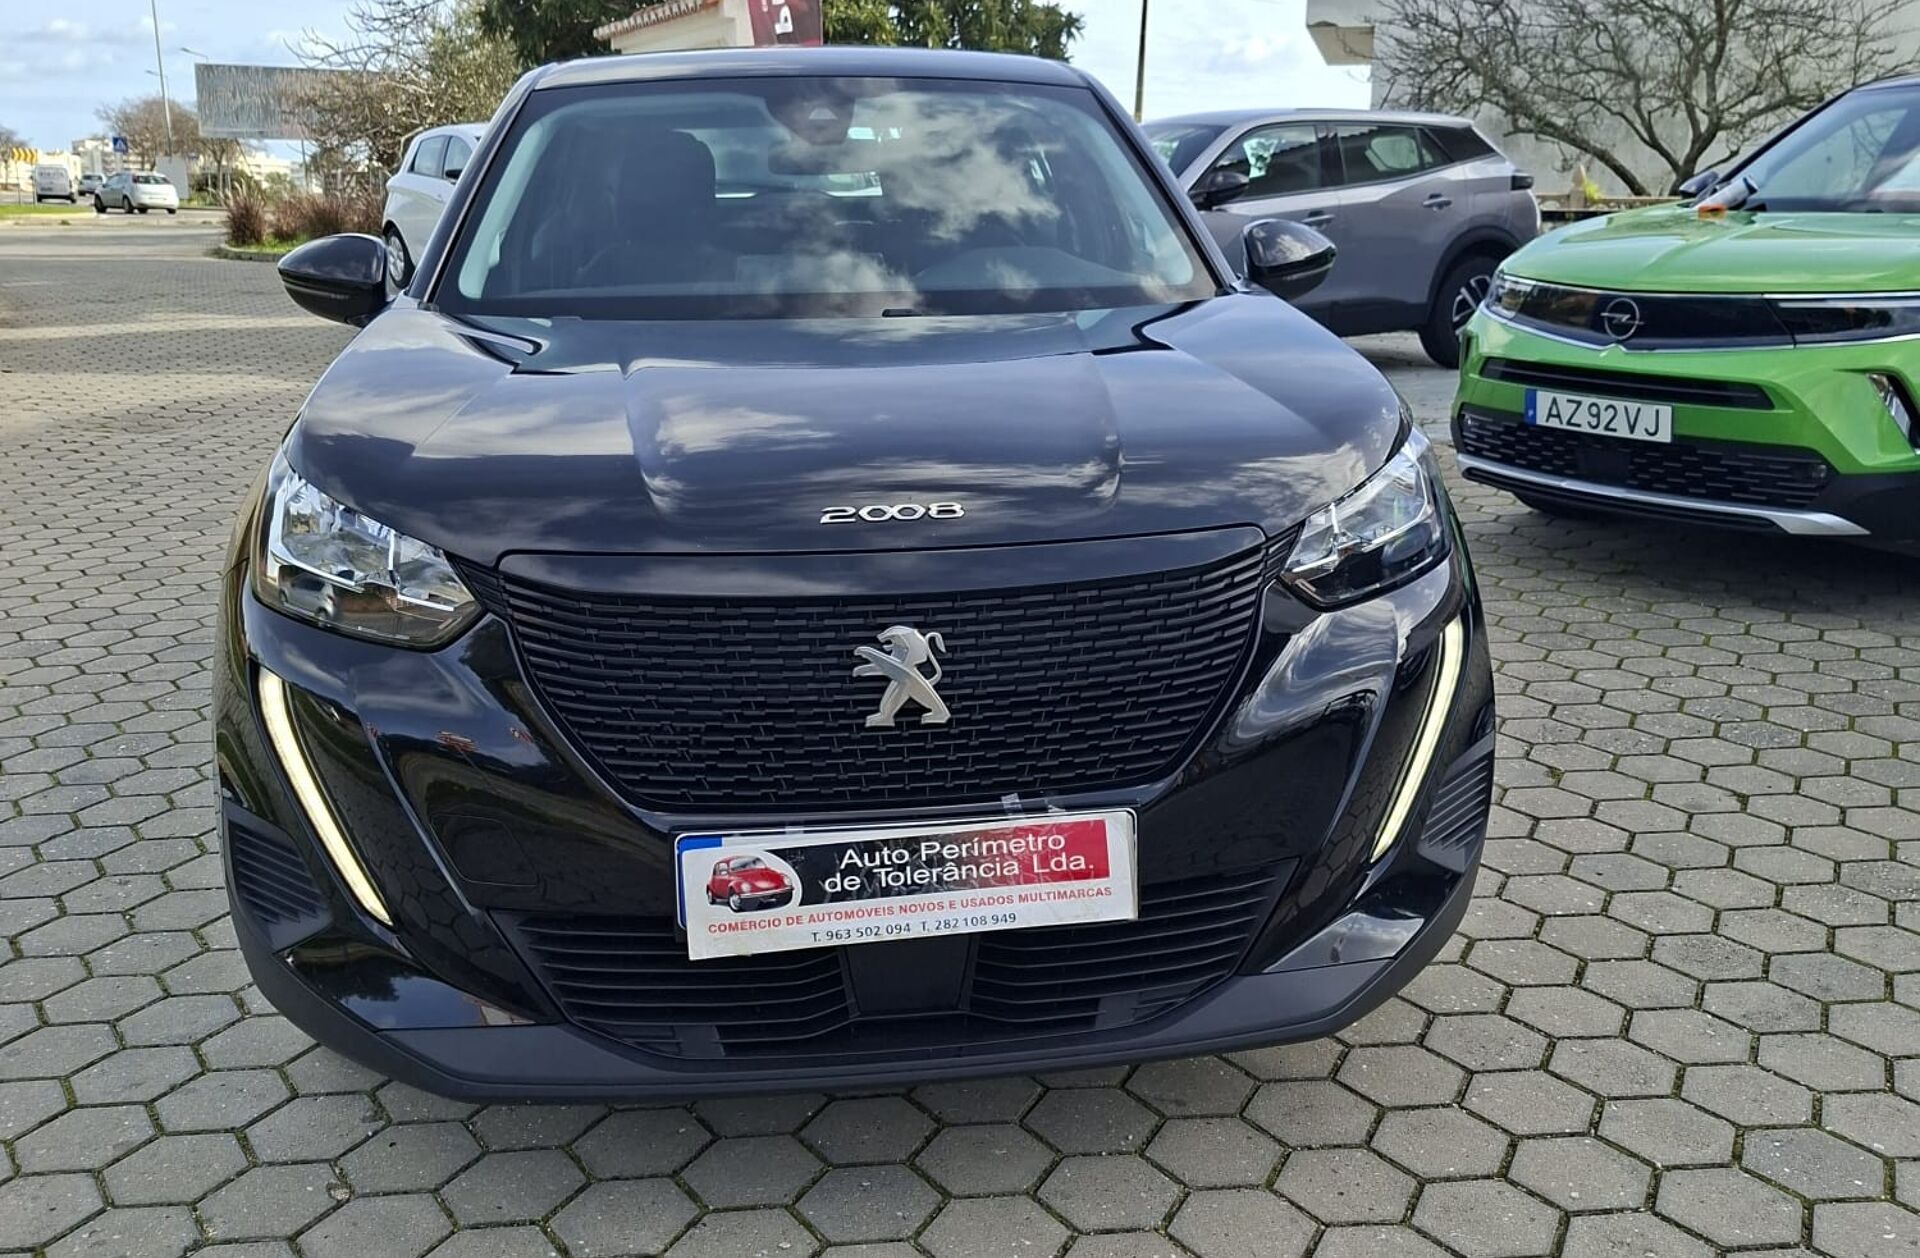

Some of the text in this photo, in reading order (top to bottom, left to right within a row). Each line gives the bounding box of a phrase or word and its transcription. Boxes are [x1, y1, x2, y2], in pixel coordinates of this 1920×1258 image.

[1545, 396, 1660, 437] AZ92VJ
[820, 502, 965, 524] 2008
[840, 833, 1066, 870] Auto Perímetro
[824, 851, 1095, 893] de Tolerância Lda.
[786, 914, 803, 926] DE
[808, 905, 895, 924] AUTOMÓVEIS
[899, 898, 945, 914] NOVOS
[949, 899, 957, 910] E
[960, 893, 1014, 909] USADOS
[1018, 887, 1112, 904] MULTIMARCAS
[812, 912, 1017, 943] T. 963 502 094 T. 282 108 949
